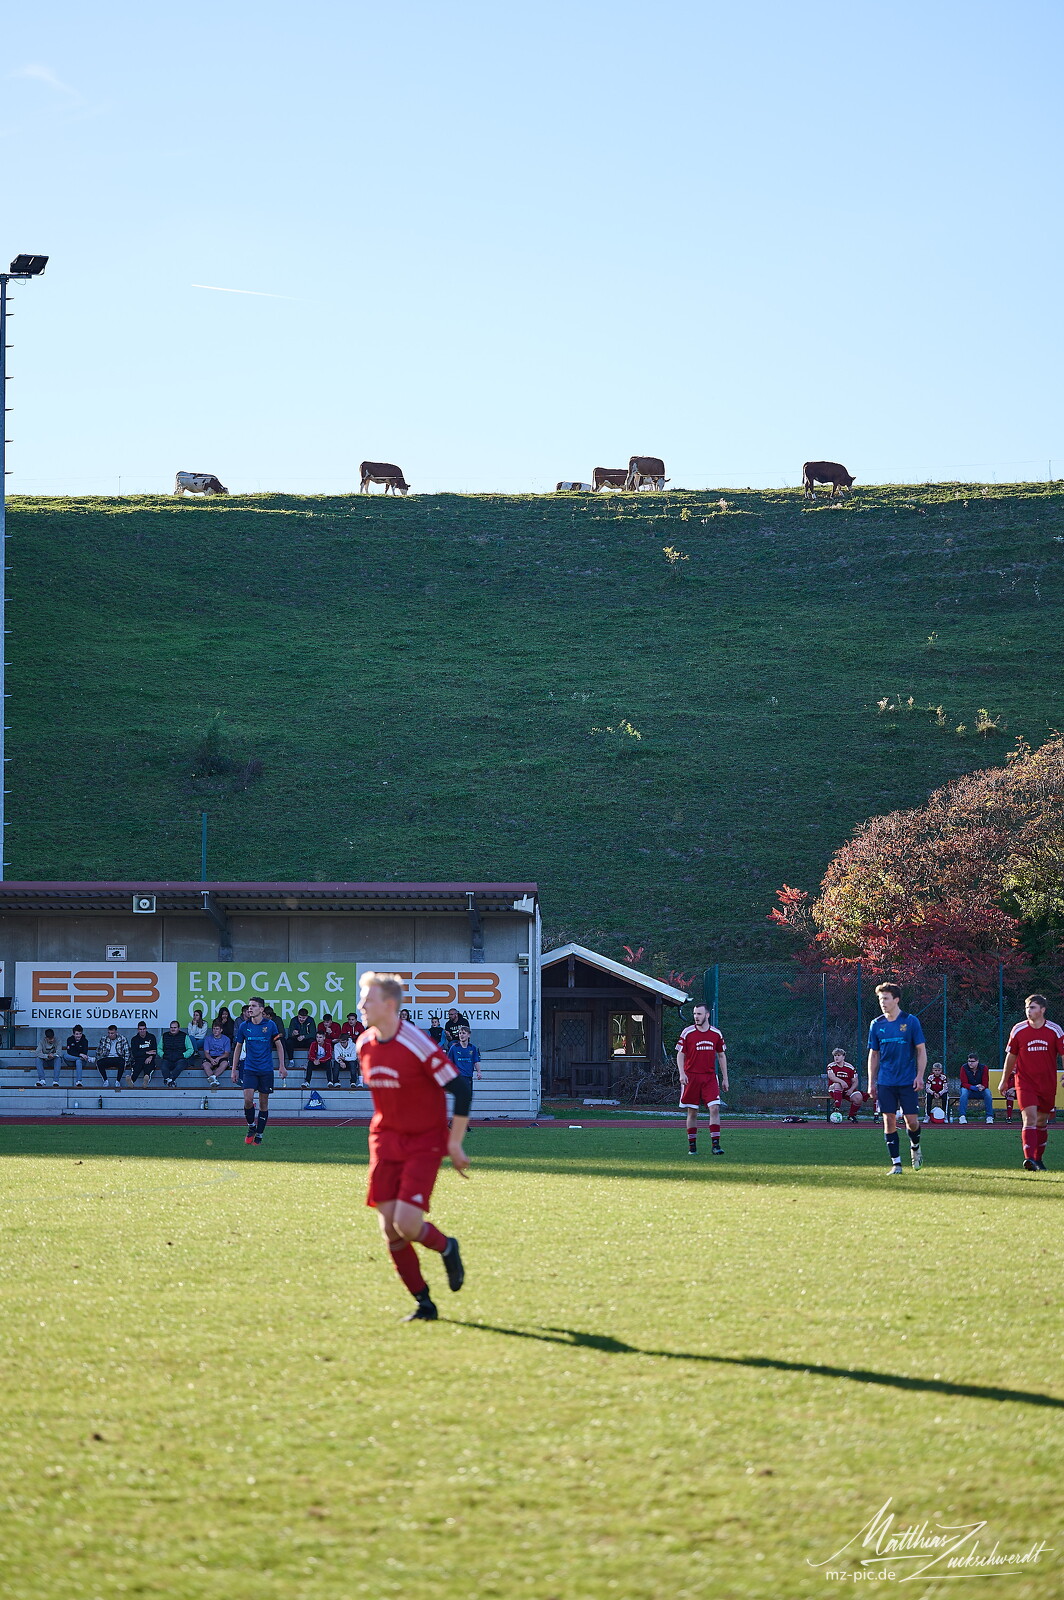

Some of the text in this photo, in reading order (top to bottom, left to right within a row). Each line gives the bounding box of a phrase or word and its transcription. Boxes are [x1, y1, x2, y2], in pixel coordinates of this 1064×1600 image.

[32, 971, 160, 1003] ESB
[189, 971, 344, 992] ERDGAS &
[31, 1006, 158, 1019] ENERGIE SÜDBAYERN
[188, 995, 343, 1021] ÖKOTROM
